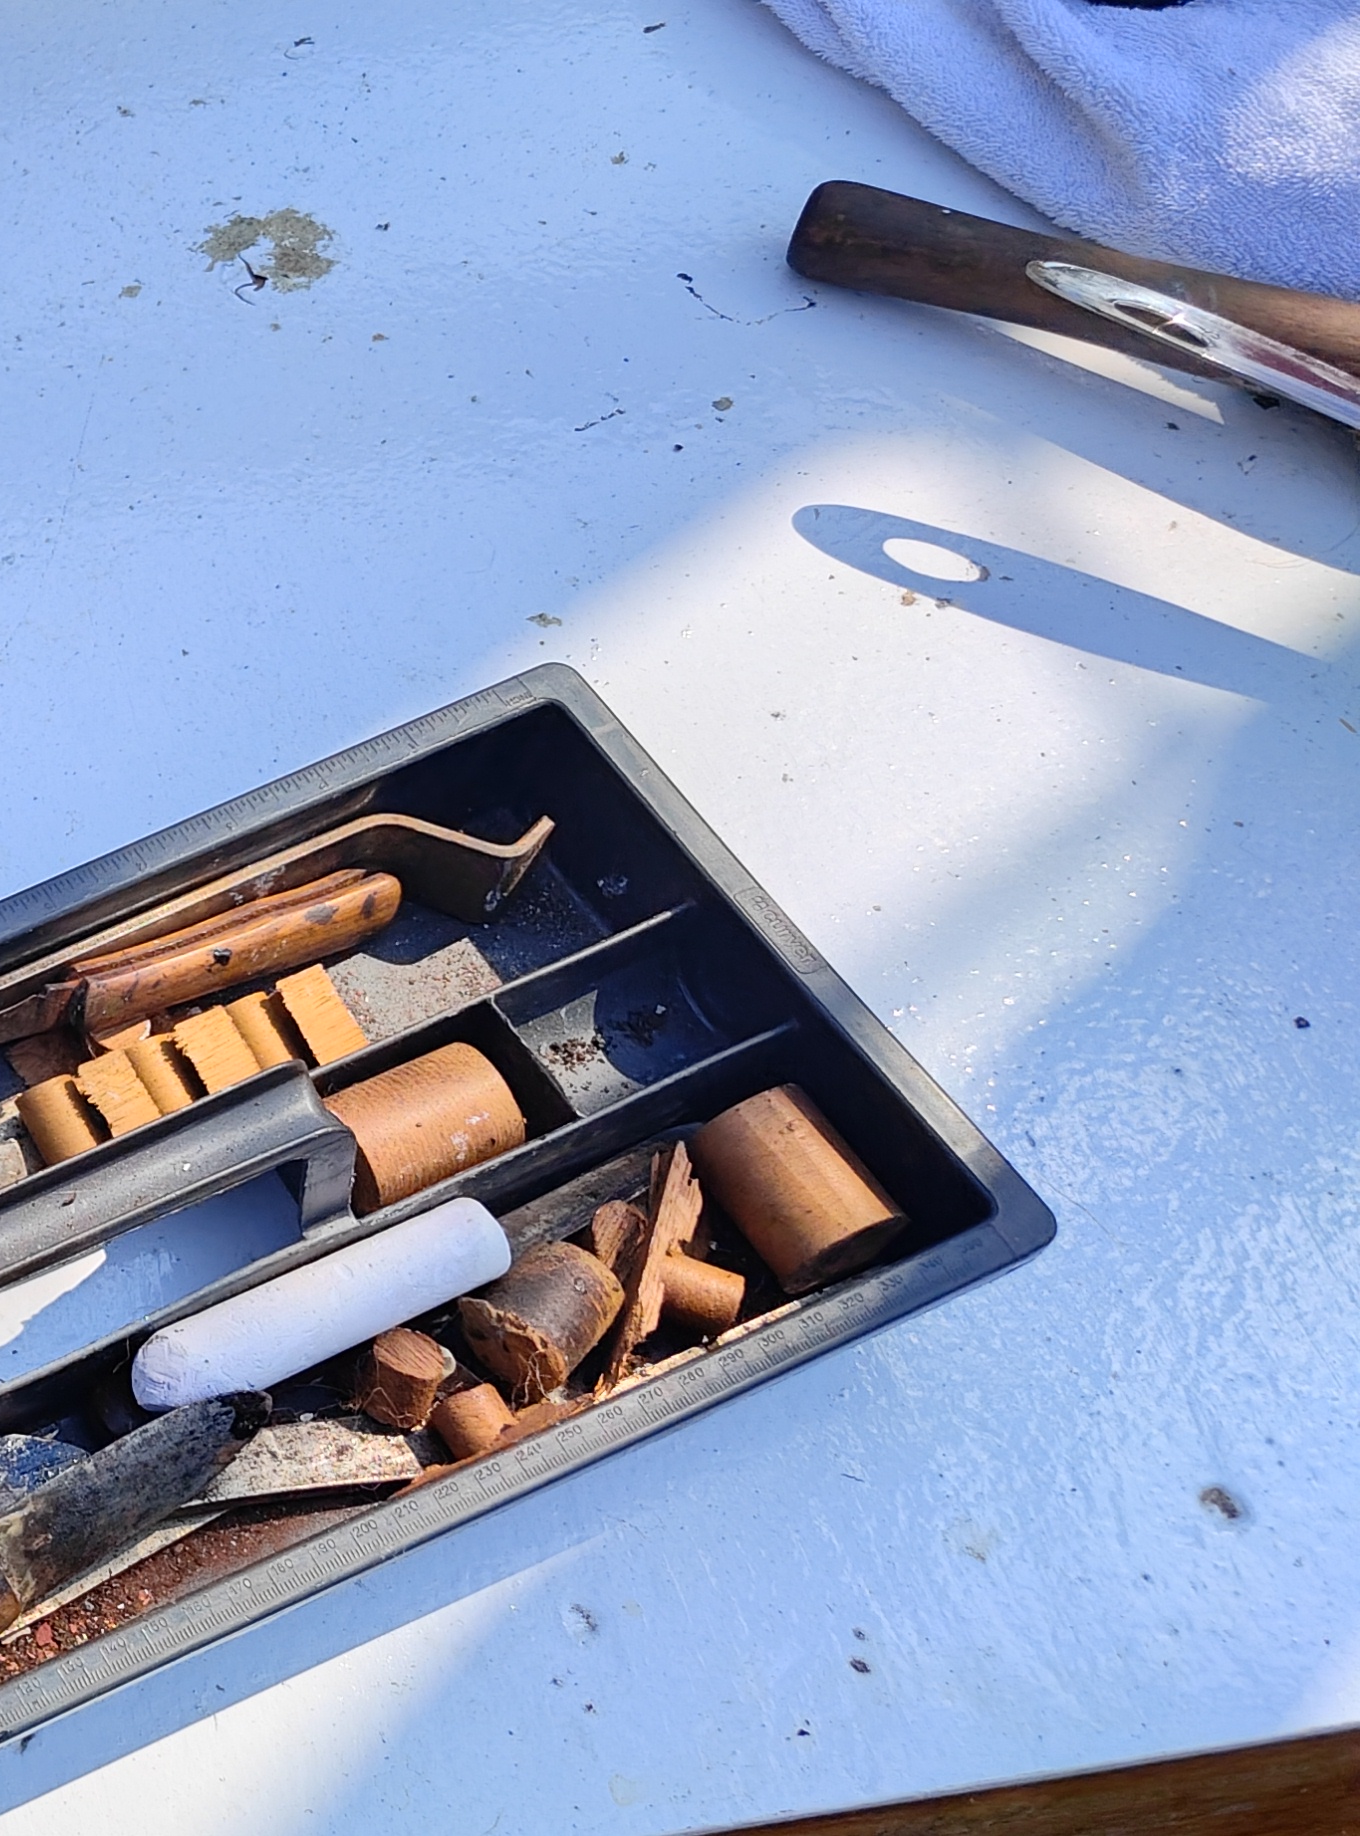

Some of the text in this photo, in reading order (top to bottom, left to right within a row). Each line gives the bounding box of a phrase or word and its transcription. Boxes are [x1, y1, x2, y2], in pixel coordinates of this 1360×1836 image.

[230, 1577, 253, 1595] 170
[313, 1538, 337, 1556] 190
[352, 1518, 378, 1538] 200
[395, 1499, 419, 1519] 210
[434, 1480, 459, 1500] 220
[476, 1461, 502, 1481] 230
[517, 1442, 542, 1461] 240
[558, 1424, 583, 1442] 250
[599, 1404, 624, 1424] 260
[639, 1385, 664, 1405] 270
[681, 1366, 706, 1386] 280
[720, 1348, 745, 1367] 290
[761, 1329, 785, 1348] 300
[801, 1311, 825, 1330] 310
[841, 1292, 865, 1310] 320
[881, 1273, 905, 1292] 330
